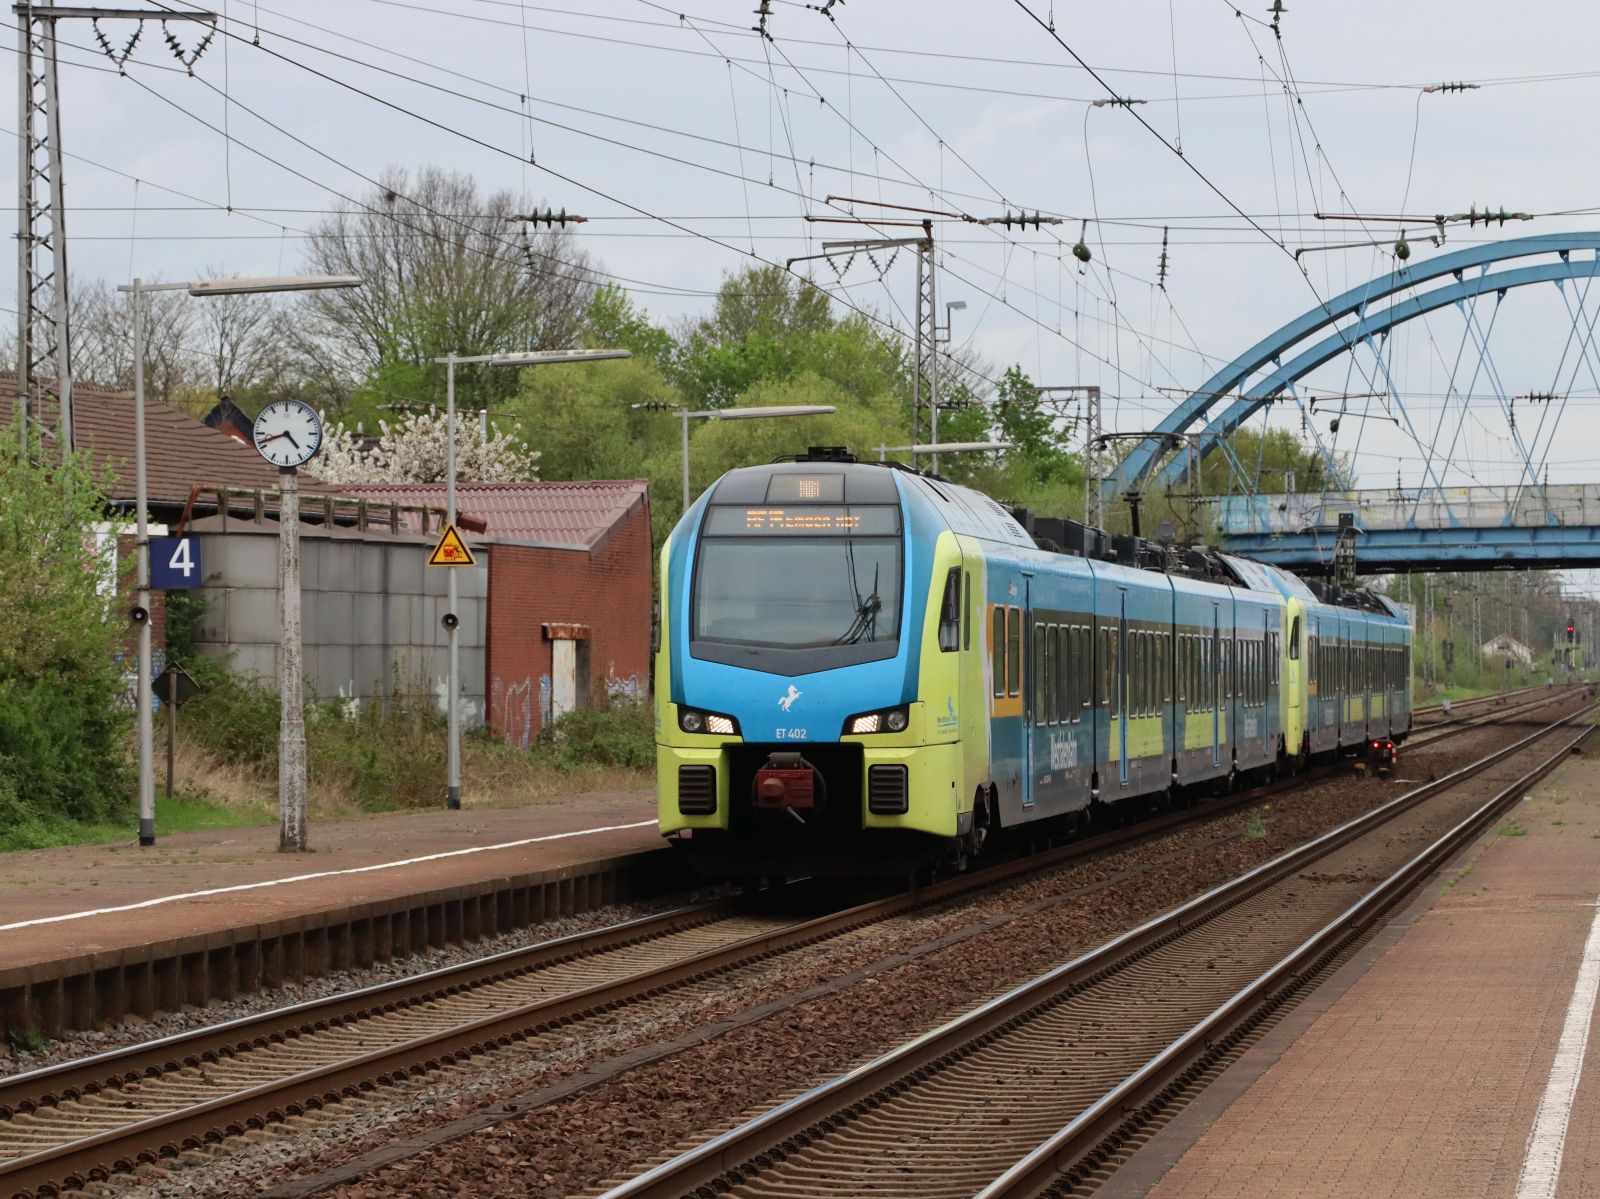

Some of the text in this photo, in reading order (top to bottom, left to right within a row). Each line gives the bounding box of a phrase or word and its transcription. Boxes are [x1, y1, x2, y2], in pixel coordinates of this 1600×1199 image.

[169, 538, 195, 577] 4
[776, 728, 807, 738] ET 402
